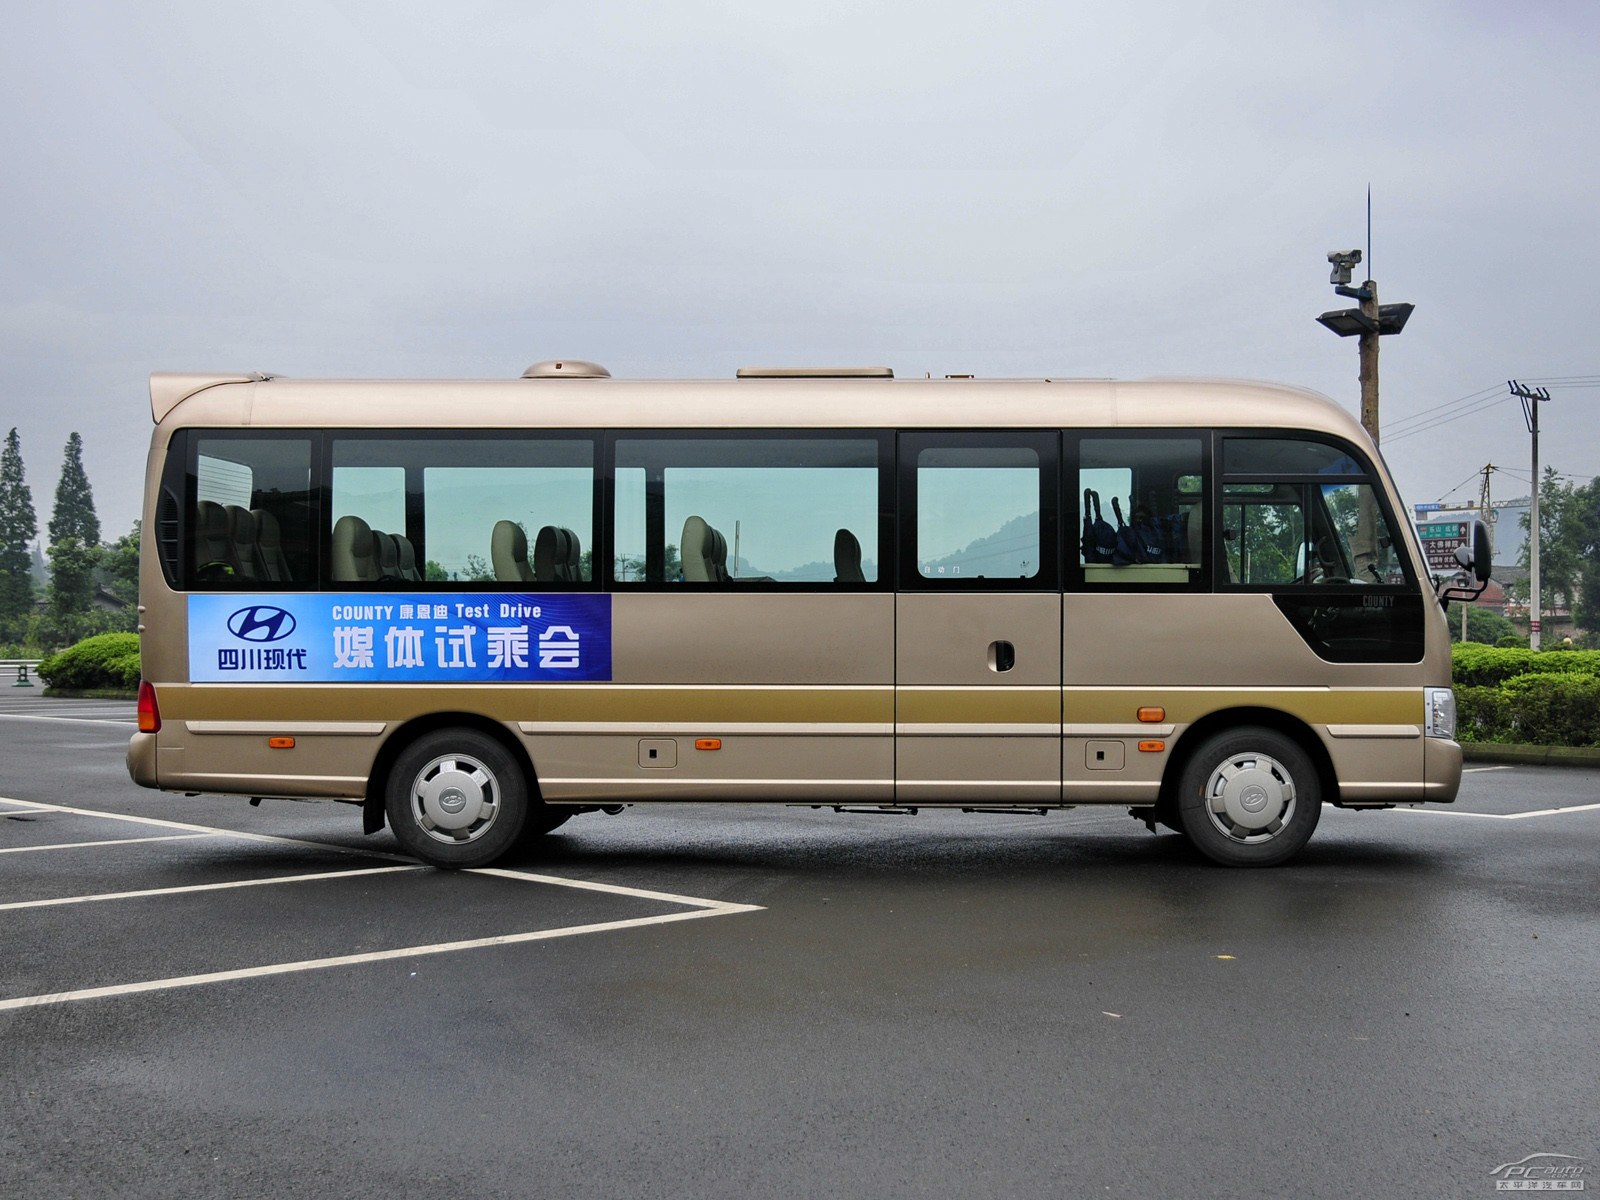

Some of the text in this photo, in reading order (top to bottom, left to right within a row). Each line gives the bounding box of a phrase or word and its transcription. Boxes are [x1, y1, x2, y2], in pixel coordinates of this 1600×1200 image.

[1362, 595, 1394, 607] COUNTY
[332, 603, 542, 620] COUNTY 康恩迪 Test Drive
[332, 625, 580, 668] 媒体试乘会
[218, 648, 307, 670] 四川现代
